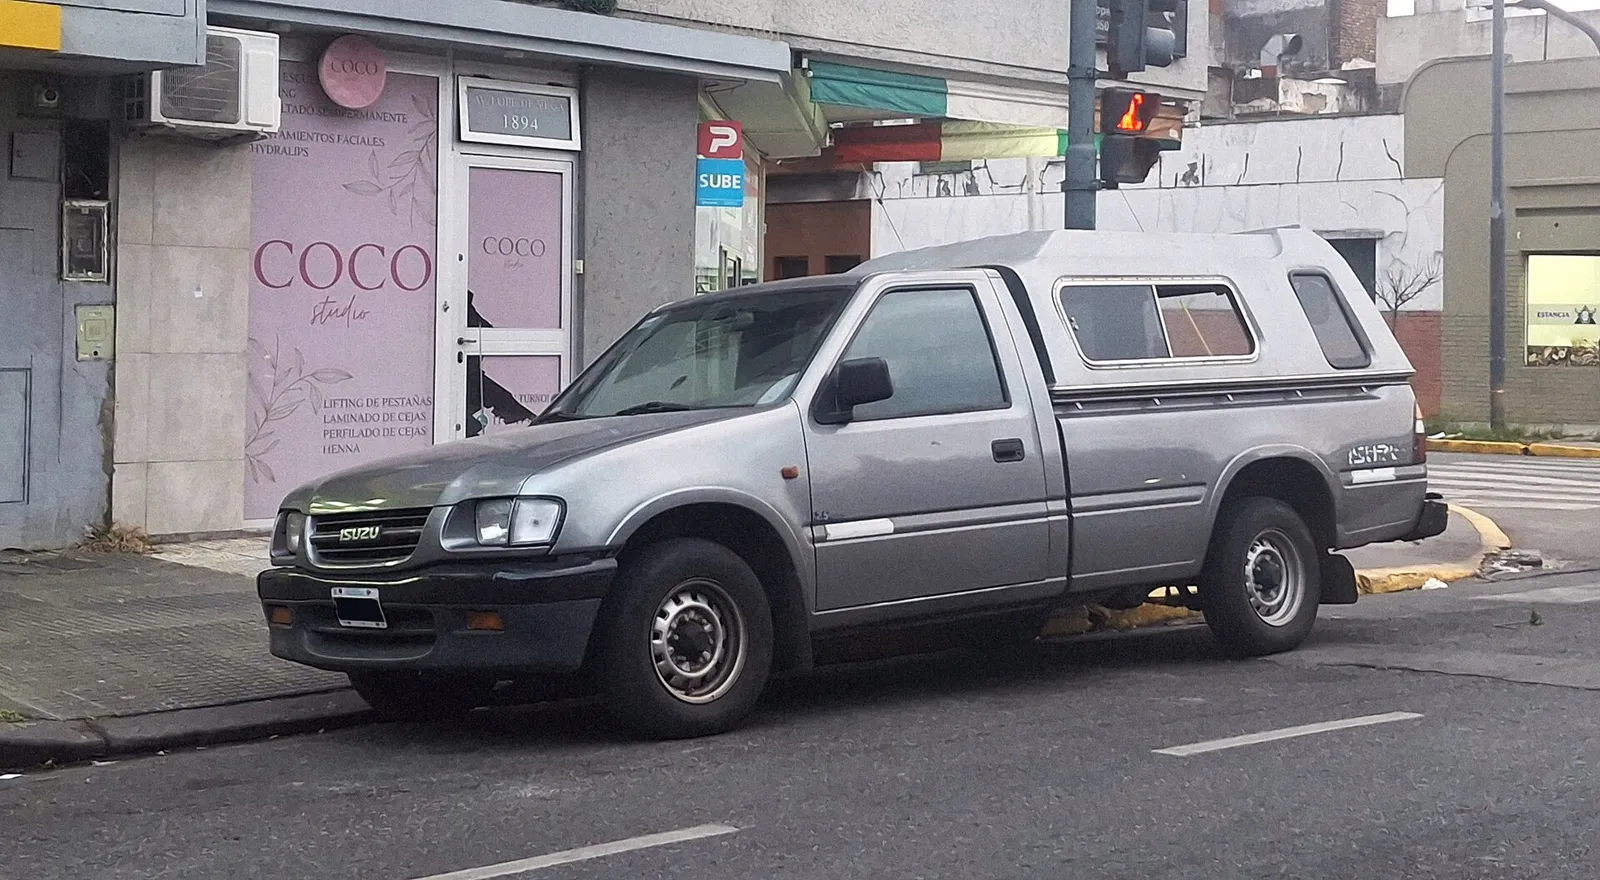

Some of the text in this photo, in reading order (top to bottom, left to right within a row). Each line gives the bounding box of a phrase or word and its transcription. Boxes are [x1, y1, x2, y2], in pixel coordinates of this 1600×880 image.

[330, 59, 378, 75] COCO
[281, 103, 315, 116] LTADO
[503, 114, 538, 130] 1894
[337, 134, 385, 146] FACIALES
[250, 143, 309, 157] HYDRALIPS
[700, 174, 741, 189] SUBE
[483, 236, 546, 257] COCO
[254, 240, 432, 291] COCO
[311, 295, 370, 328] studio
[1537, 311, 1570, 319] ESTANCIA
[324, 395, 432, 409] LIFTING DE PESTAÑAS
[324, 412, 427, 424] LAMINADO DE CEJAS
[324, 427, 427, 439] PERFILADO DE CEJAS
[323, 443, 361, 454] HENNA
[339, 526, 379, 541] ISUZU
